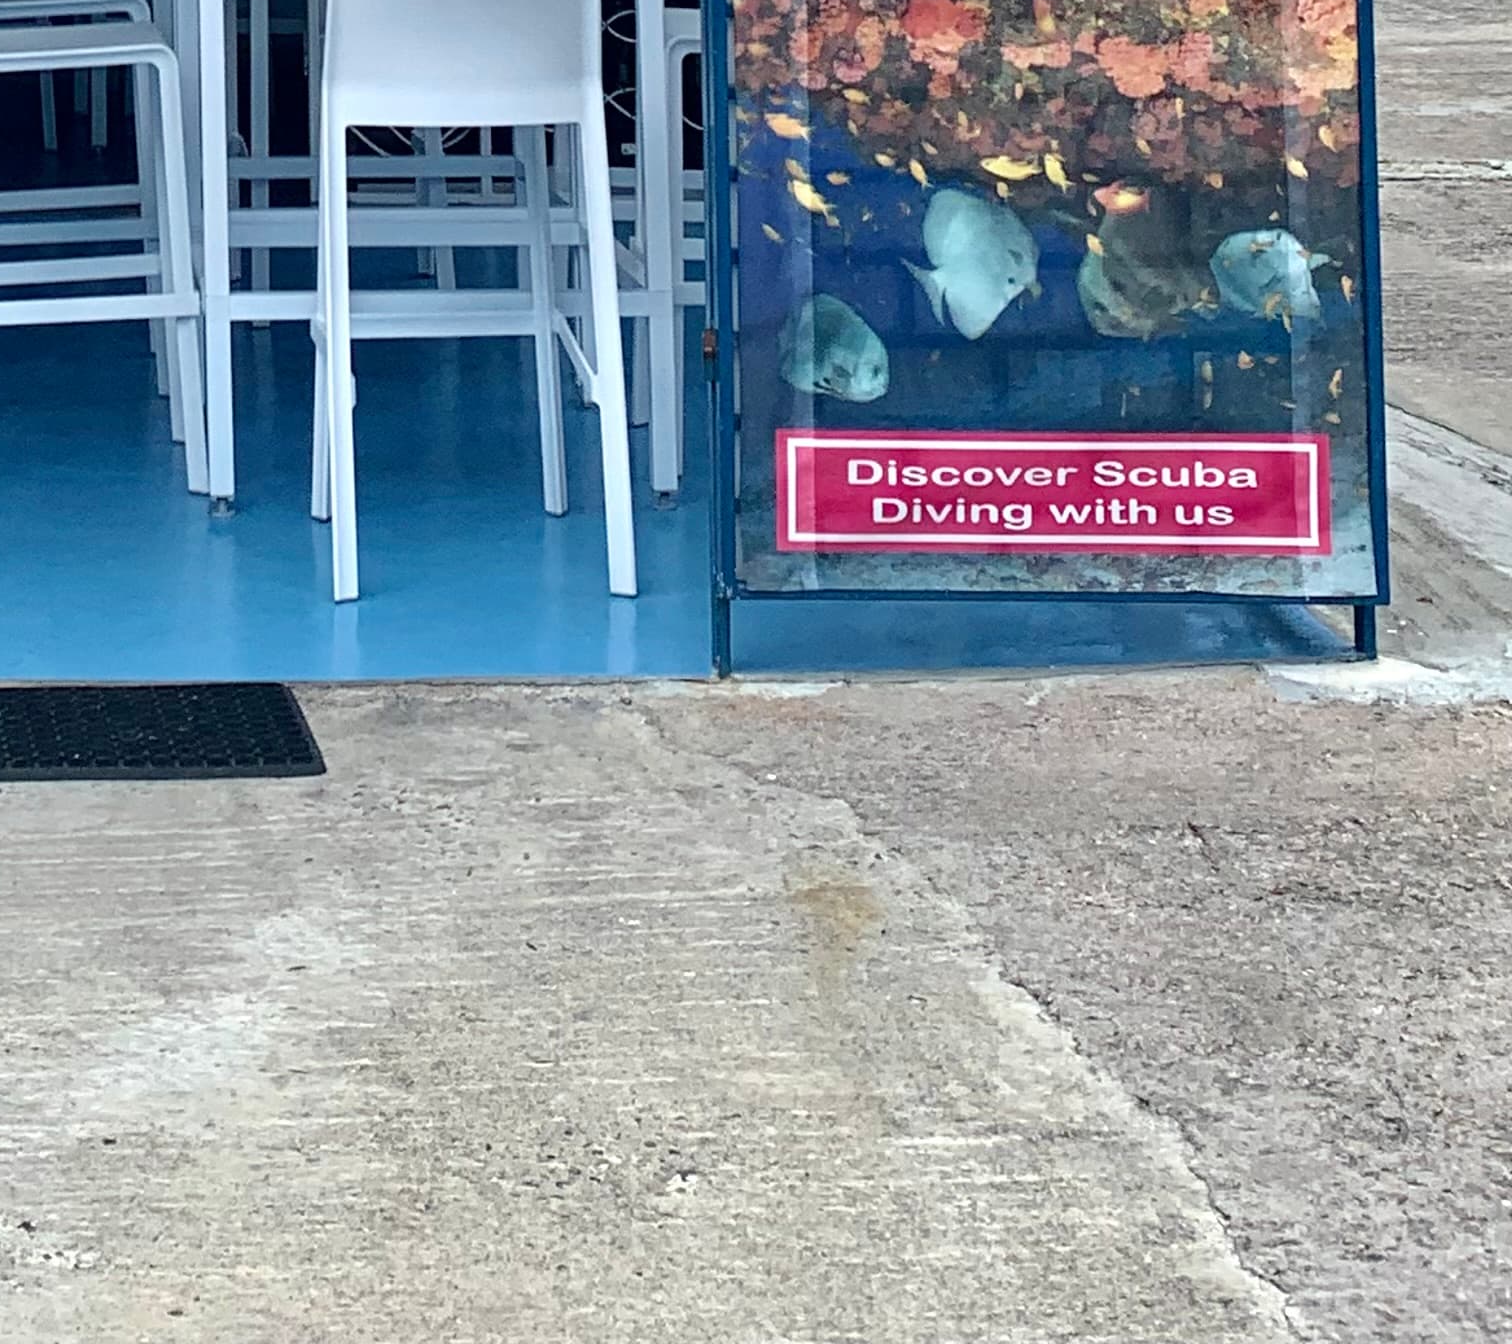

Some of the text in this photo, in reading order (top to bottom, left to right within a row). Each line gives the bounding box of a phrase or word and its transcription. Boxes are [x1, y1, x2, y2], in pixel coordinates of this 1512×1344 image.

[847, 458, 1259, 489] Discover Scuba
[871, 496, 1235, 531] Diving with us
